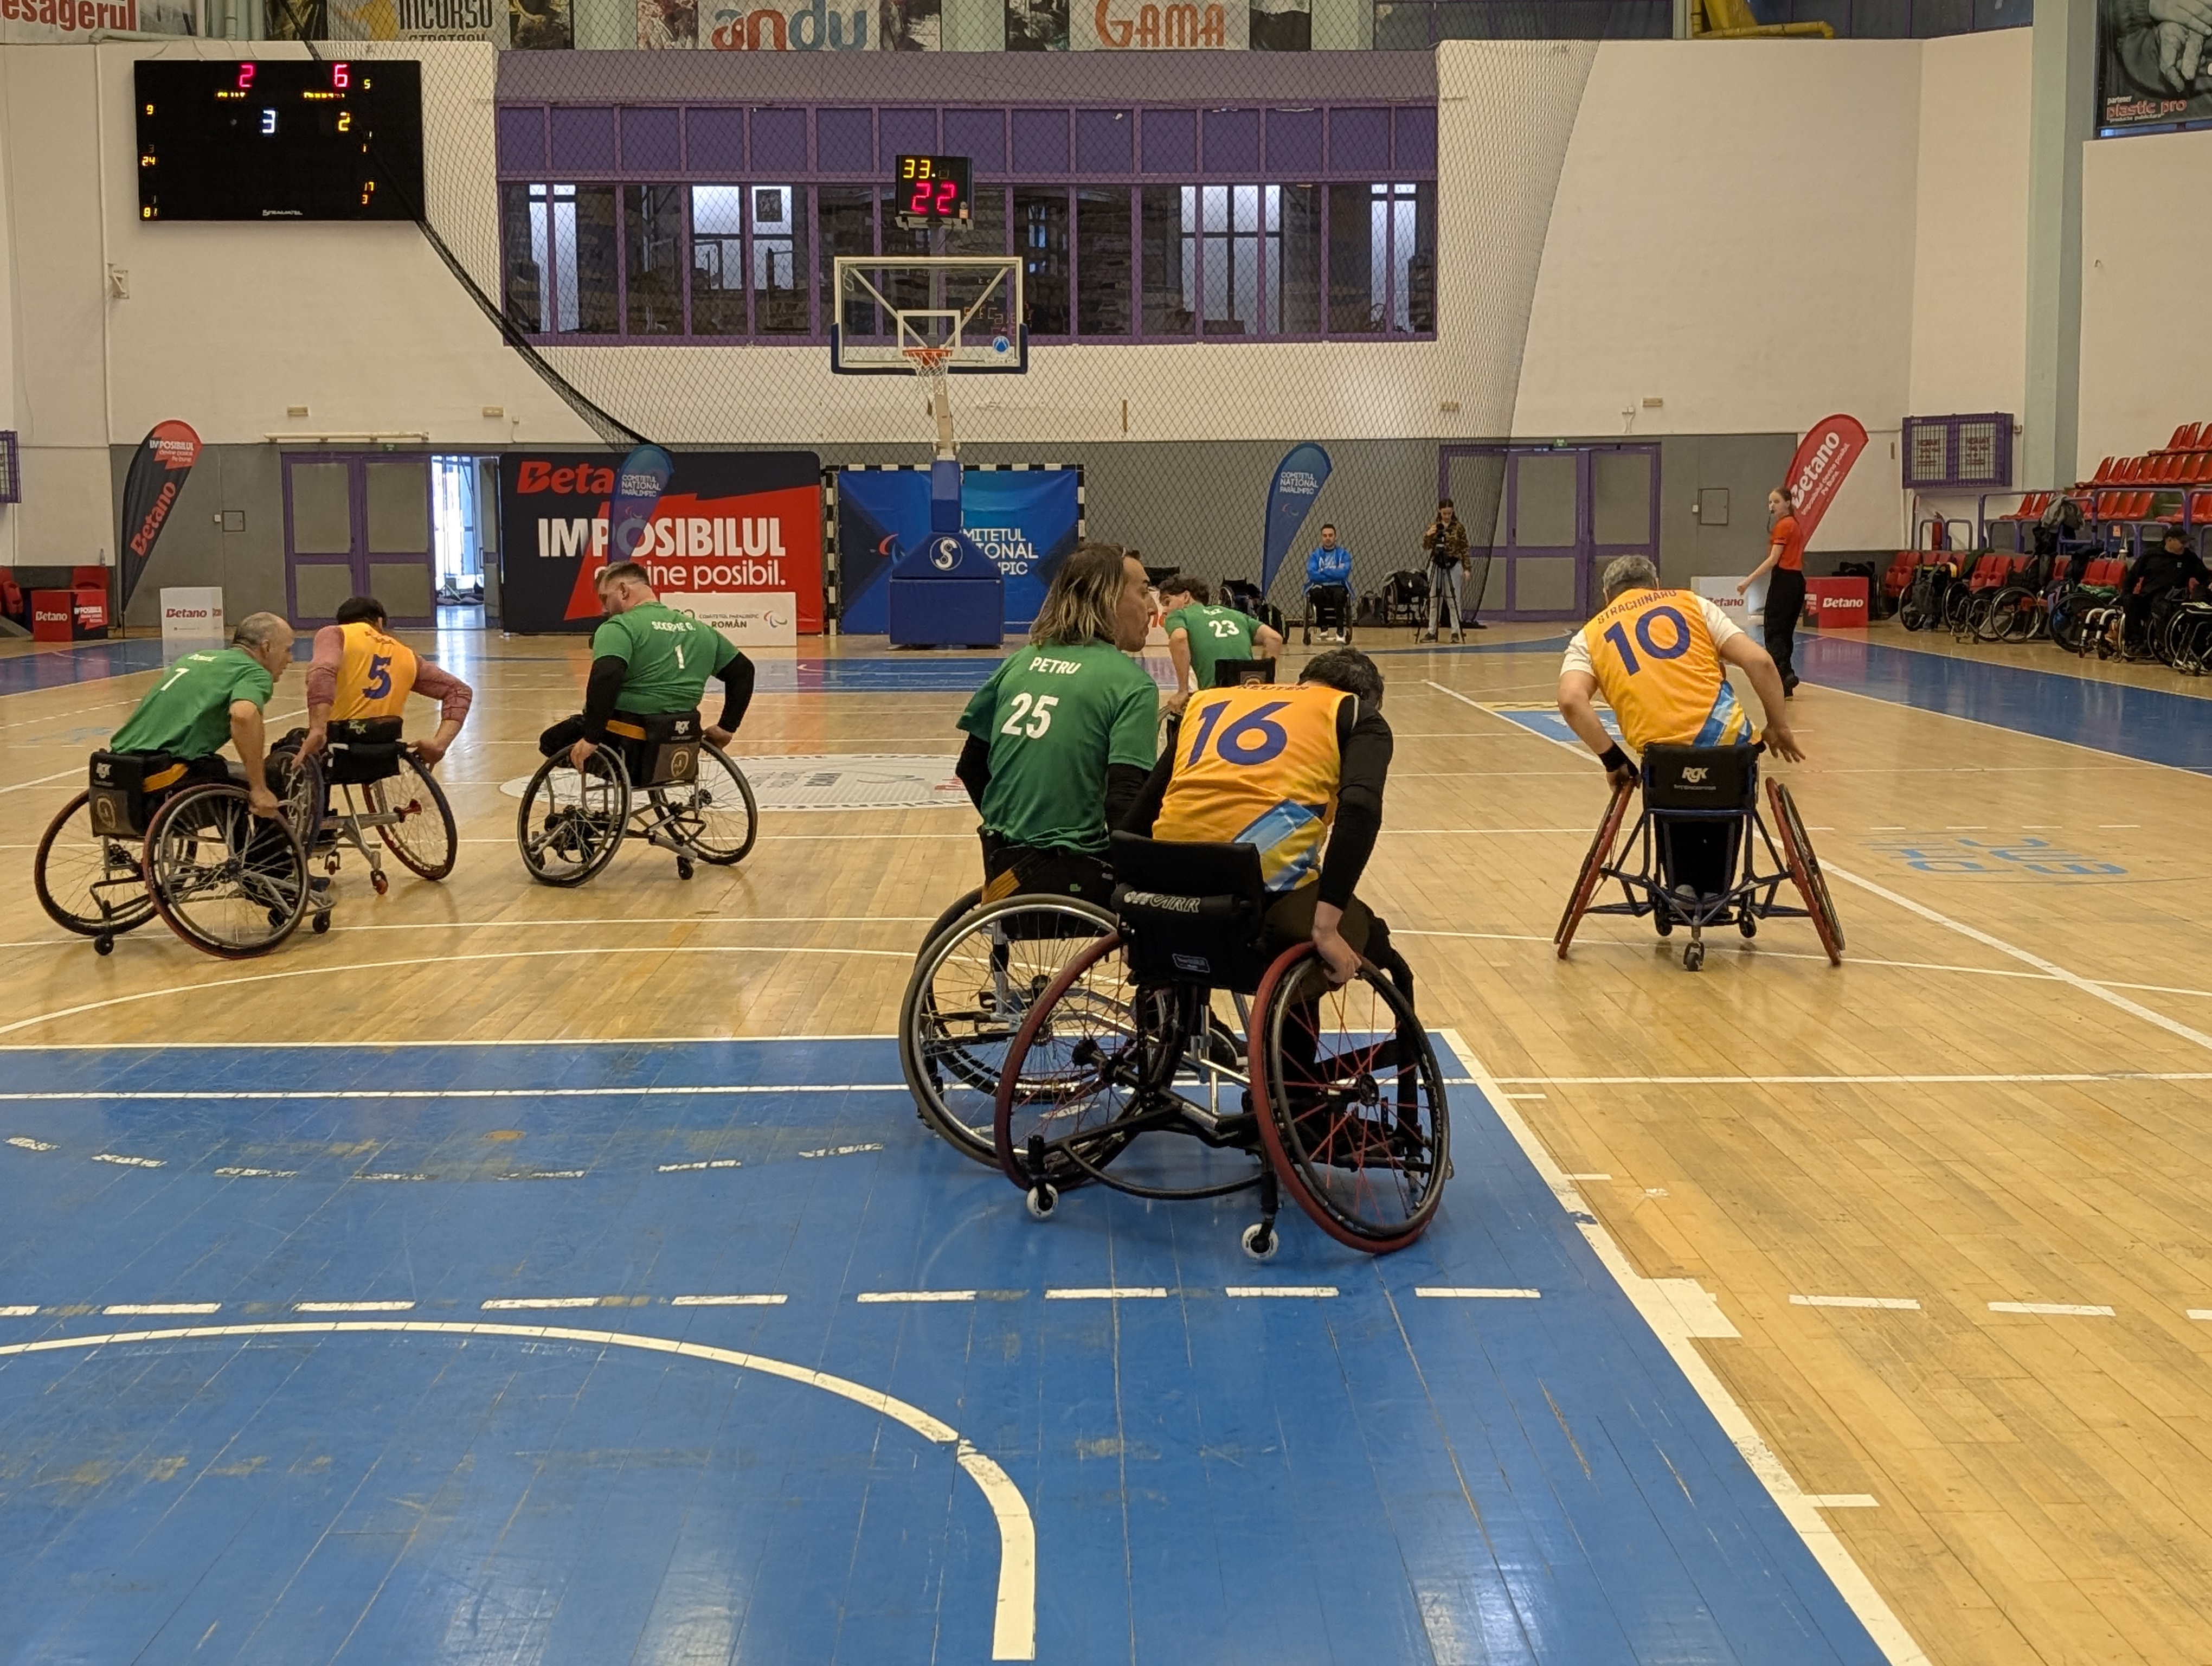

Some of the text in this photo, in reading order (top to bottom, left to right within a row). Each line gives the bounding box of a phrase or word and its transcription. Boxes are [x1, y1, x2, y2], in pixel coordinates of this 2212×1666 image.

[239, 65, 253, 87] 2
[335, 65, 348, 87] 6
[146, 105, 153, 114] 9
[2106, 100, 2187, 120] plastic pro
[262, 110, 275, 133] 3
[338, 112, 350, 131] 2
[142, 156, 156, 166] 24
[911, 183, 955, 212] 22
[130, 482, 176, 557] Betano
[538, 517, 786, 558] IMPOSIBILUL
[693, 559, 786, 590] posibil.
[166, 608, 207, 618] Betano
[1822, 597, 1864, 608] Betano
[35, 611, 68, 621] Betano
[1208, 620, 1239, 638] 23
[1604, 605, 1691, 676] 10
[674, 644, 685, 669] 1
[1028, 657, 1082, 675] PETRU
[362, 653, 392, 699] 5
[1001, 692, 1059, 739] 25
[1186, 700, 1293, 768] 16
